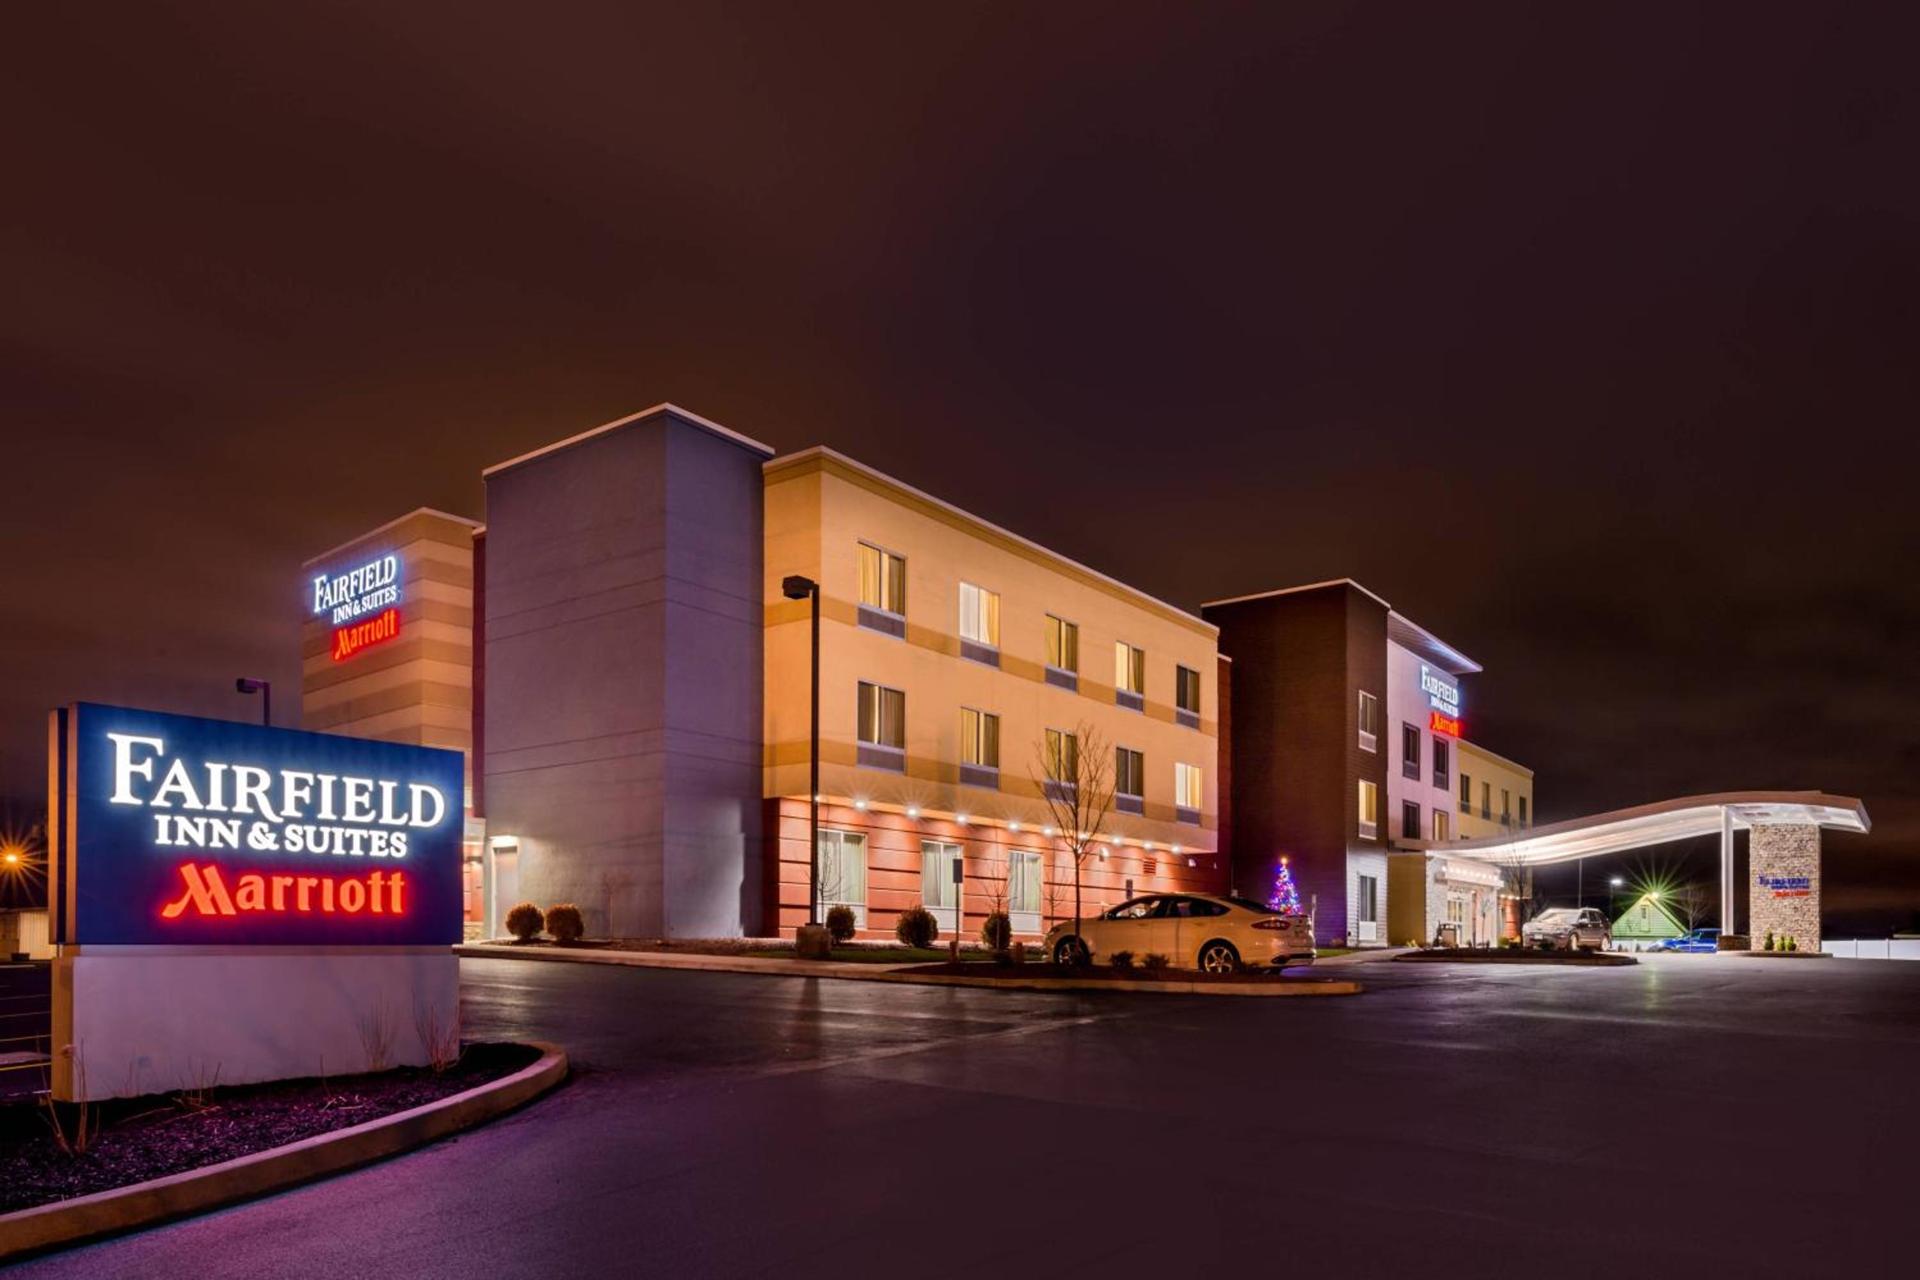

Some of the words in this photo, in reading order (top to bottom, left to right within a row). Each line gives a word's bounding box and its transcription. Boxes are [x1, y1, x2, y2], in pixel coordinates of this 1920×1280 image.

[313, 556, 396, 613] FAIRFIELD
[333, 605, 352, 624] INN
[361, 585, 397, 612] SUITES
[334, 608, 396, 660] Marriott
[106, 732, 446, 828] FAIRFIELD
[154, 814, 243, 848] INN
[246, 822, 280, 852] &
[284, 823, 409, 859] SUITES
[161, 862, 405, 919] Marriott
